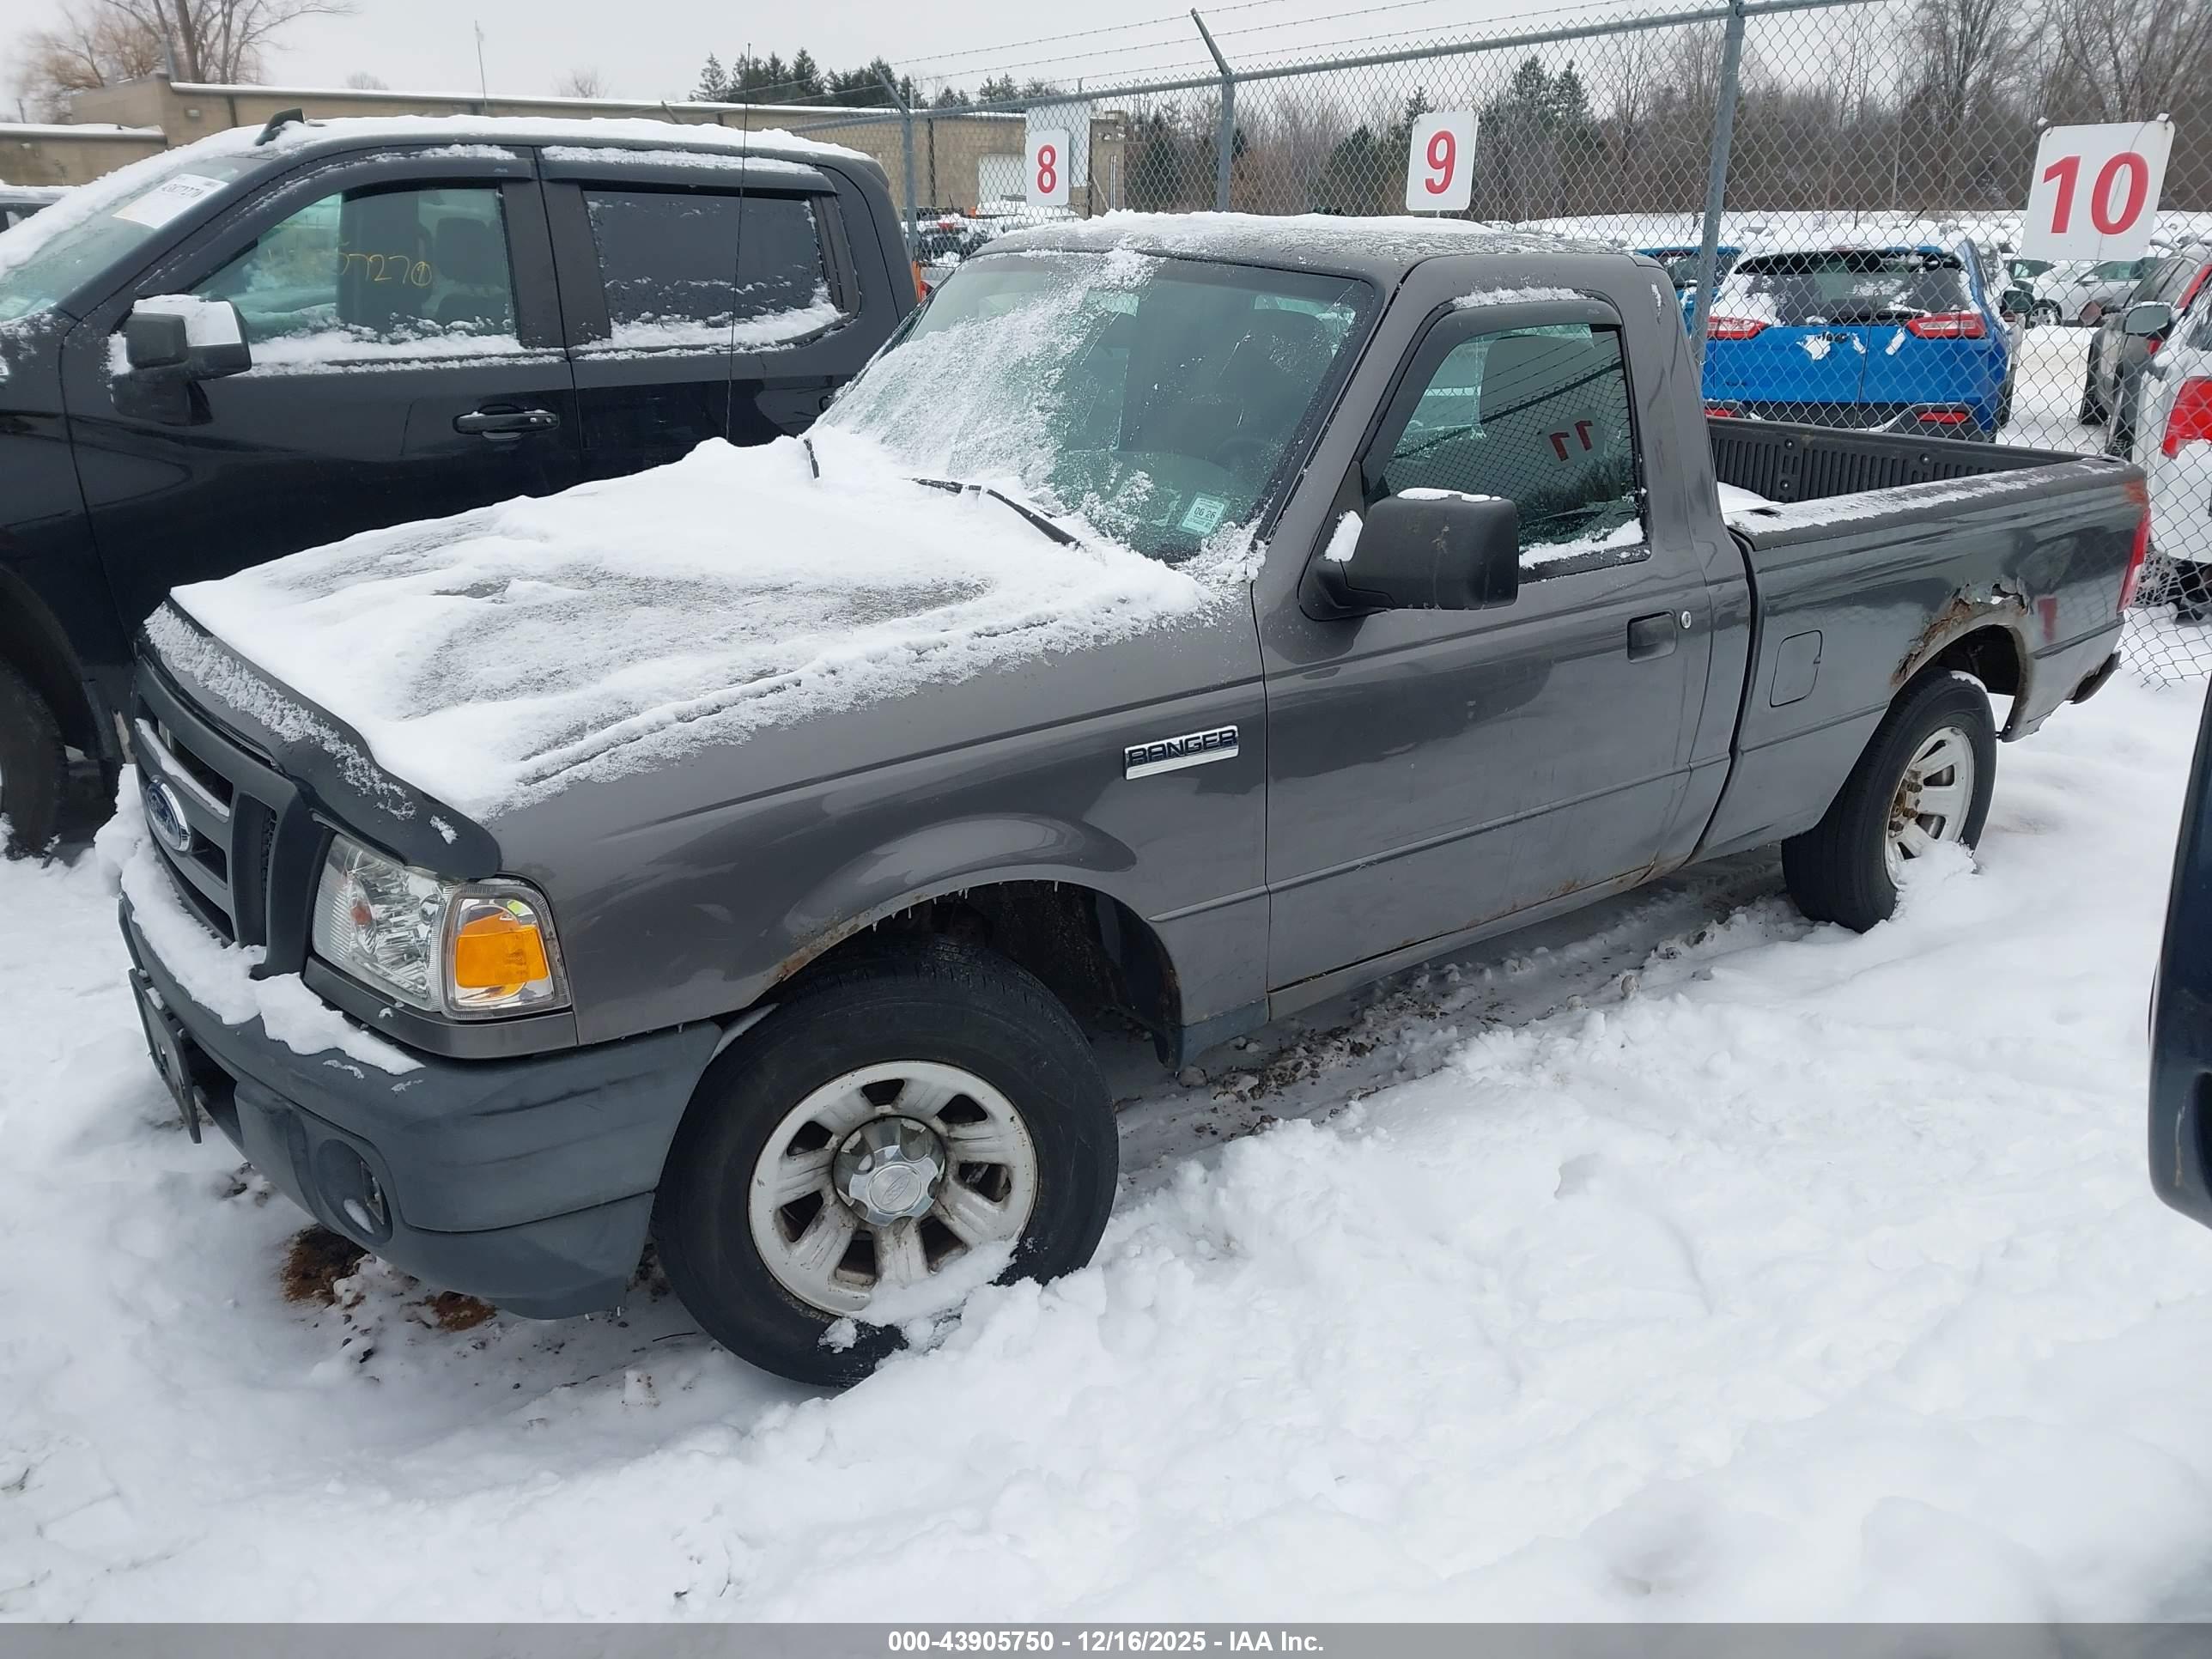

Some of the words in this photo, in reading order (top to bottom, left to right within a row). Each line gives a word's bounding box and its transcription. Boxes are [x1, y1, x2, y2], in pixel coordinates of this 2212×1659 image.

[1036, 144, 1057, 194] 8
[1425, 131, 1455, 194] 9
[2043, 152, 2148, 235] 10
[1127, 728, 1238, 767] RANGER
